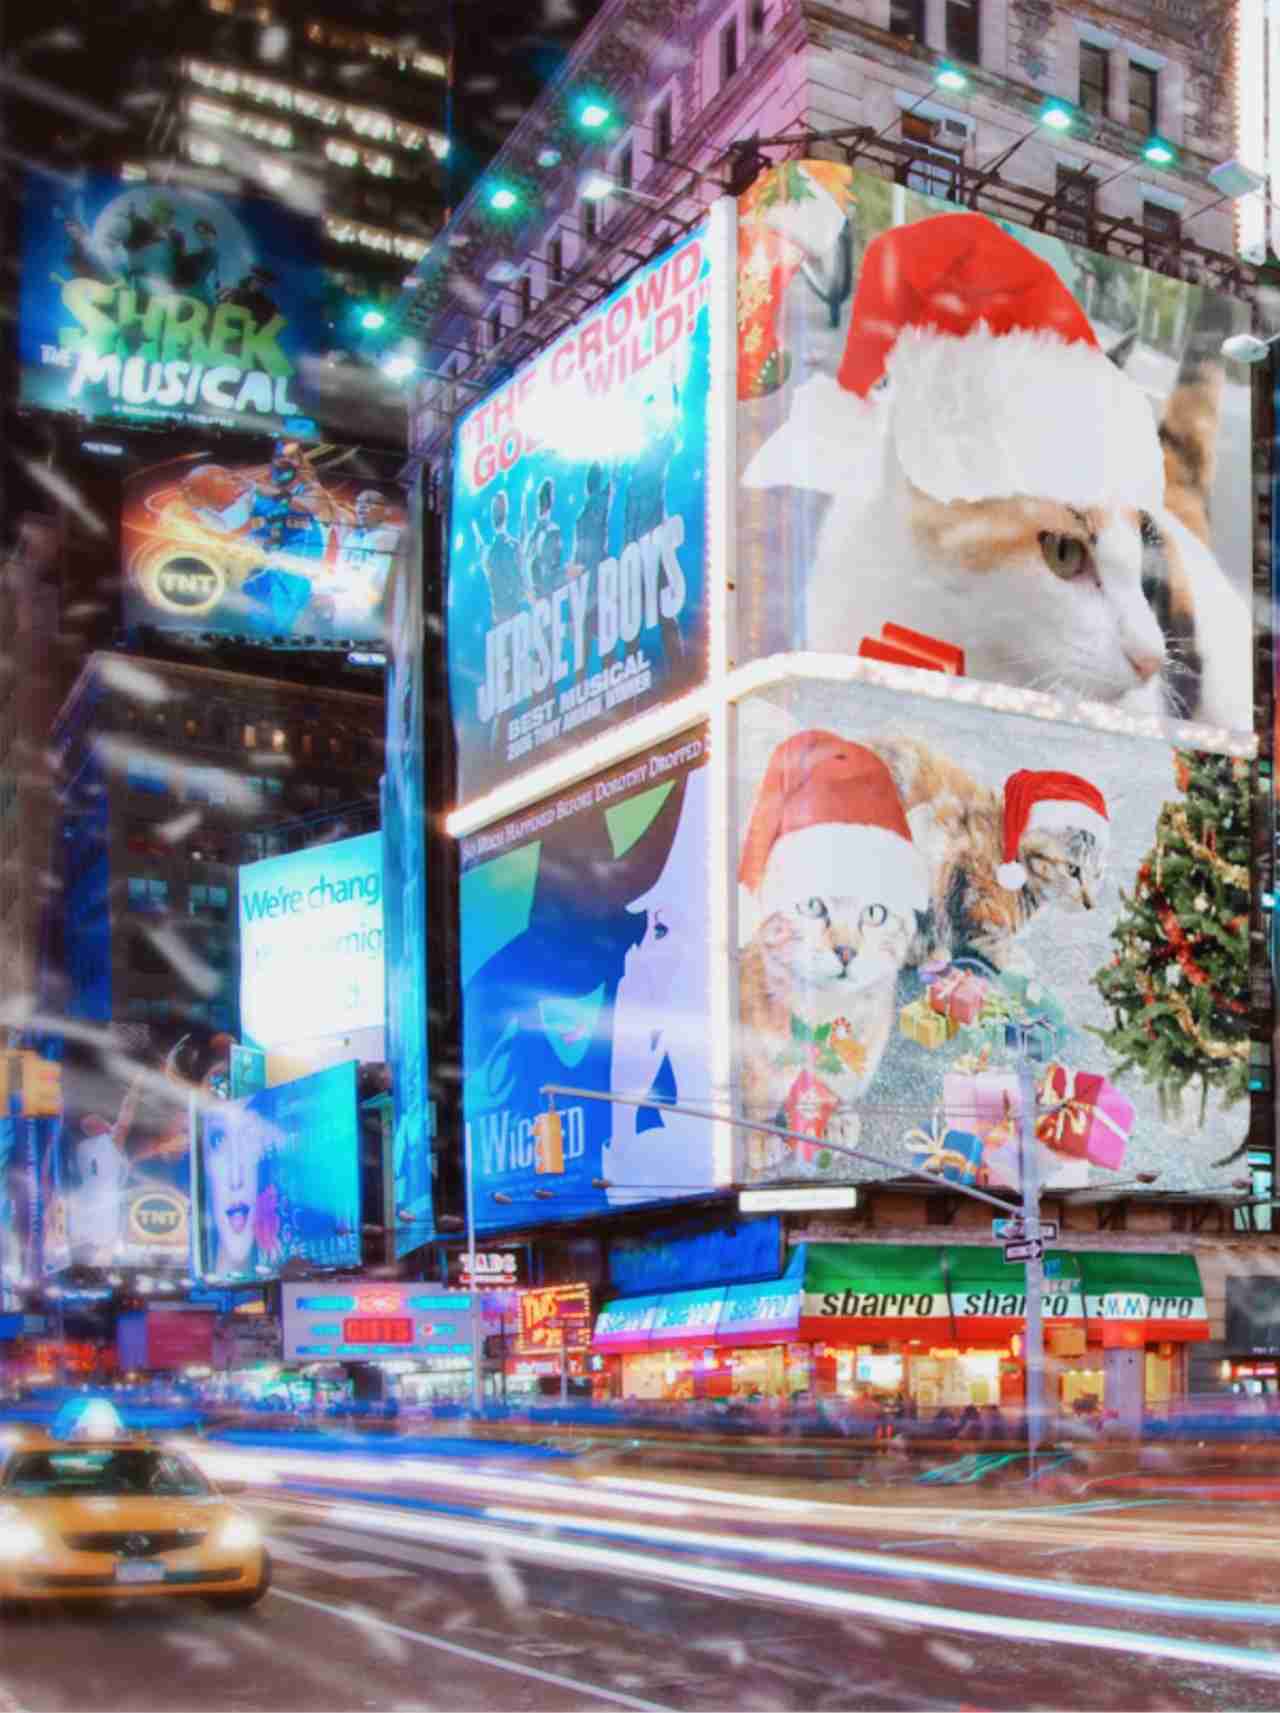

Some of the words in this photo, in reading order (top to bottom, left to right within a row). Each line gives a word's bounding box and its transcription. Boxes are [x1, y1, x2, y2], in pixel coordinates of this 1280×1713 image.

[53, 273, 290, 376] SHREK
[551, 242, 701, 384] CROWD
[68, 348, 298, 415] MUSICAL
[159, 573, 216, 593] TNT
[600, 515, 686, 657] BOYS
[508, 700, 555, 741] BEST
[243, 886, 303, 921] We're
[140, 1209, 177, 1226] TNT
[821, 1289, 934, 1317] sbarro
